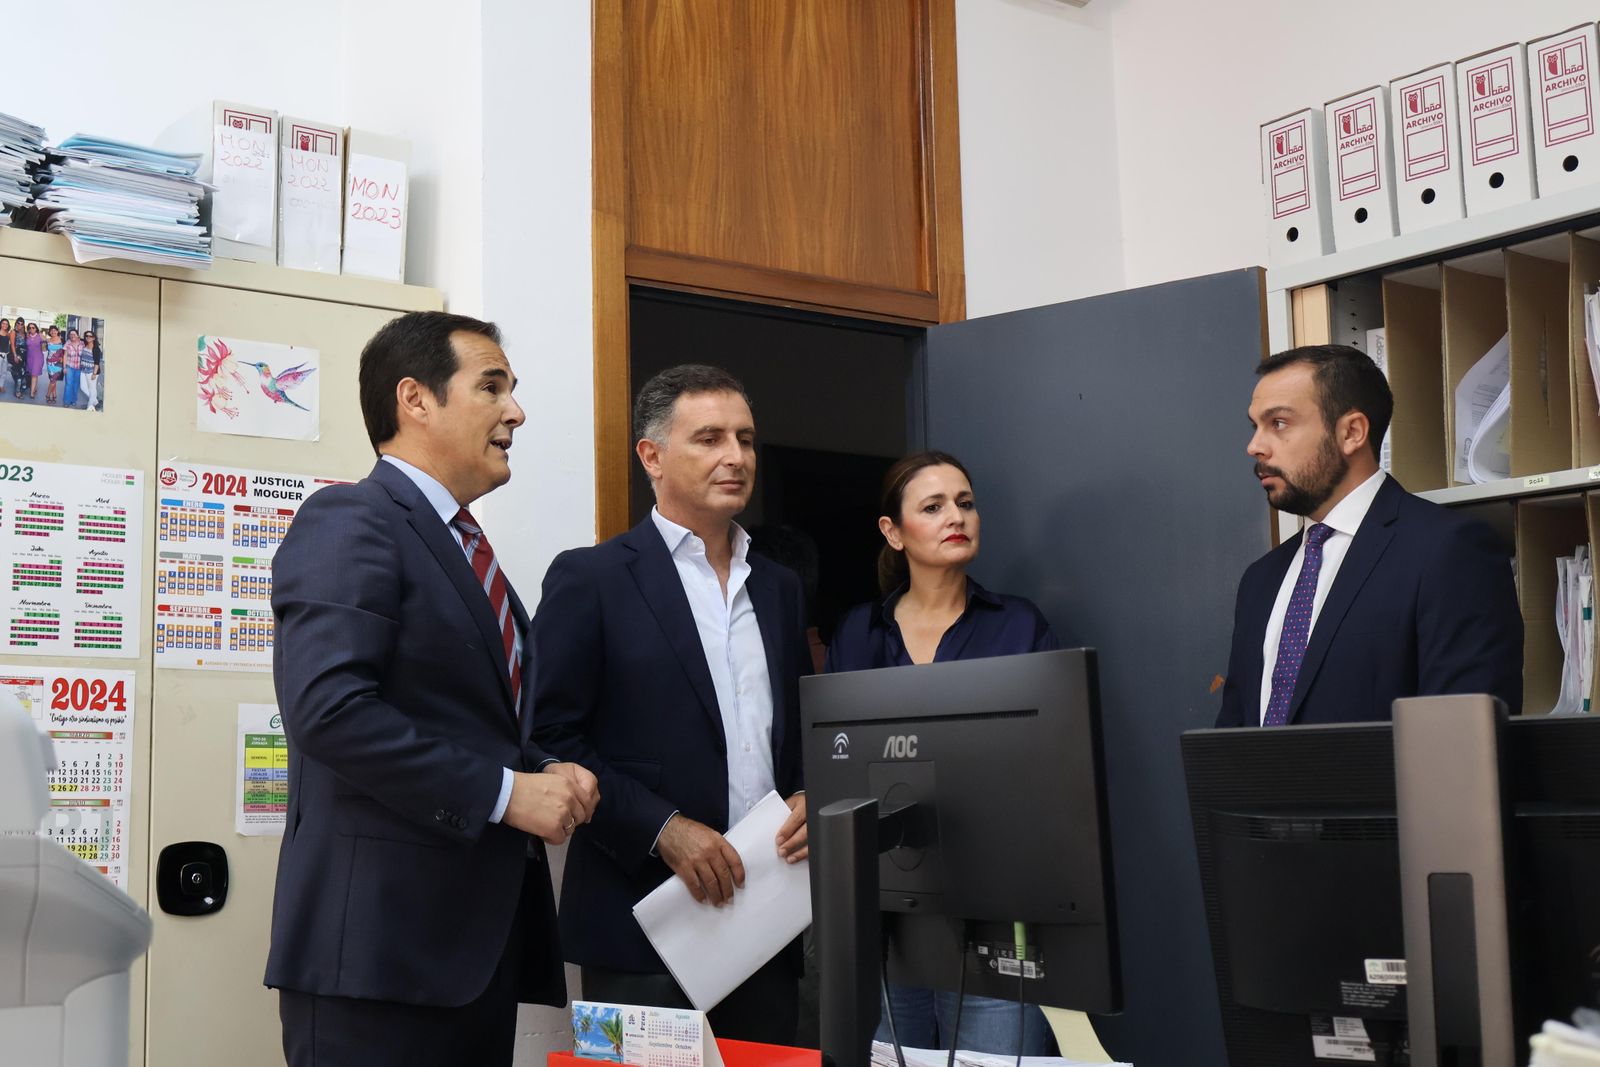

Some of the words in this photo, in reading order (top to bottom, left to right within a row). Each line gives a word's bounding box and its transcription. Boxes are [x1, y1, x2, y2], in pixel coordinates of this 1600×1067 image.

[1545, 74, 1586, 93] ARCHIVO
[1473, 95, 1512, 112] ARCHIVO
[1406, 112, 1443, 129] ARCHIVO
[1340, 134, 1375, 150] ARCHIVO
[1274, 154, 1304, 170] ARCHIVO
[351, 177, 398, 200] MON
[352, 203, 400, 229] 2023
[202, 472, 247, 497] 2024
[252, 476, 304, 488] JUSTICIA
[254, 488, 303, 500] MOGUER
[170, 605, 210, 614] SEPTIEMBRE
[51, 678, 126, 711] 2024
[883, 735, 918, 758] AOC
